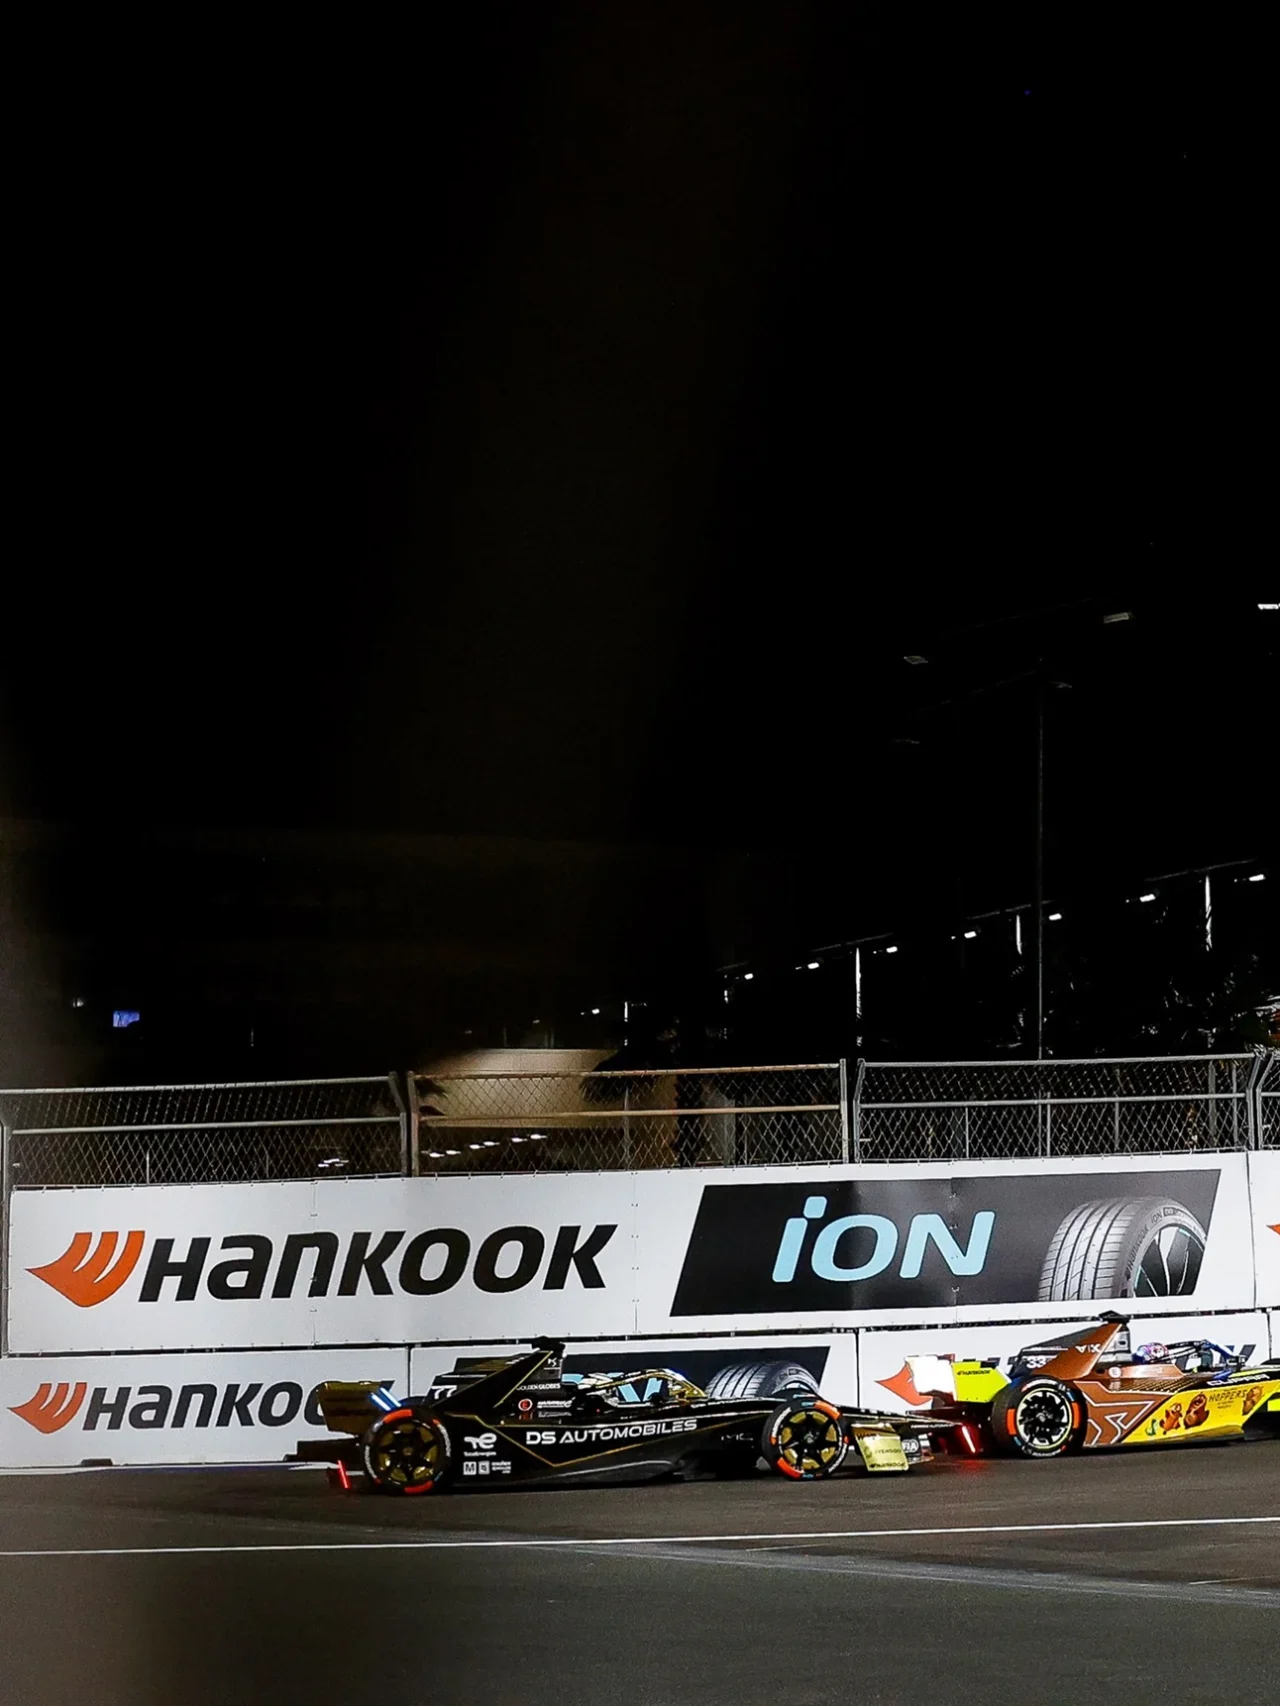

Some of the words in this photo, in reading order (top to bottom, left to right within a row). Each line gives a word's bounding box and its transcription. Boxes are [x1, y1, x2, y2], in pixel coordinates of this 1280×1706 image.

[1026, 1355, 1047, 1369] 33
[431, 1385, 457, 1399] 77
[526, 1430, 556, 1446] DS
[559, 1418, 698, 1445] AUTOMOBILES
